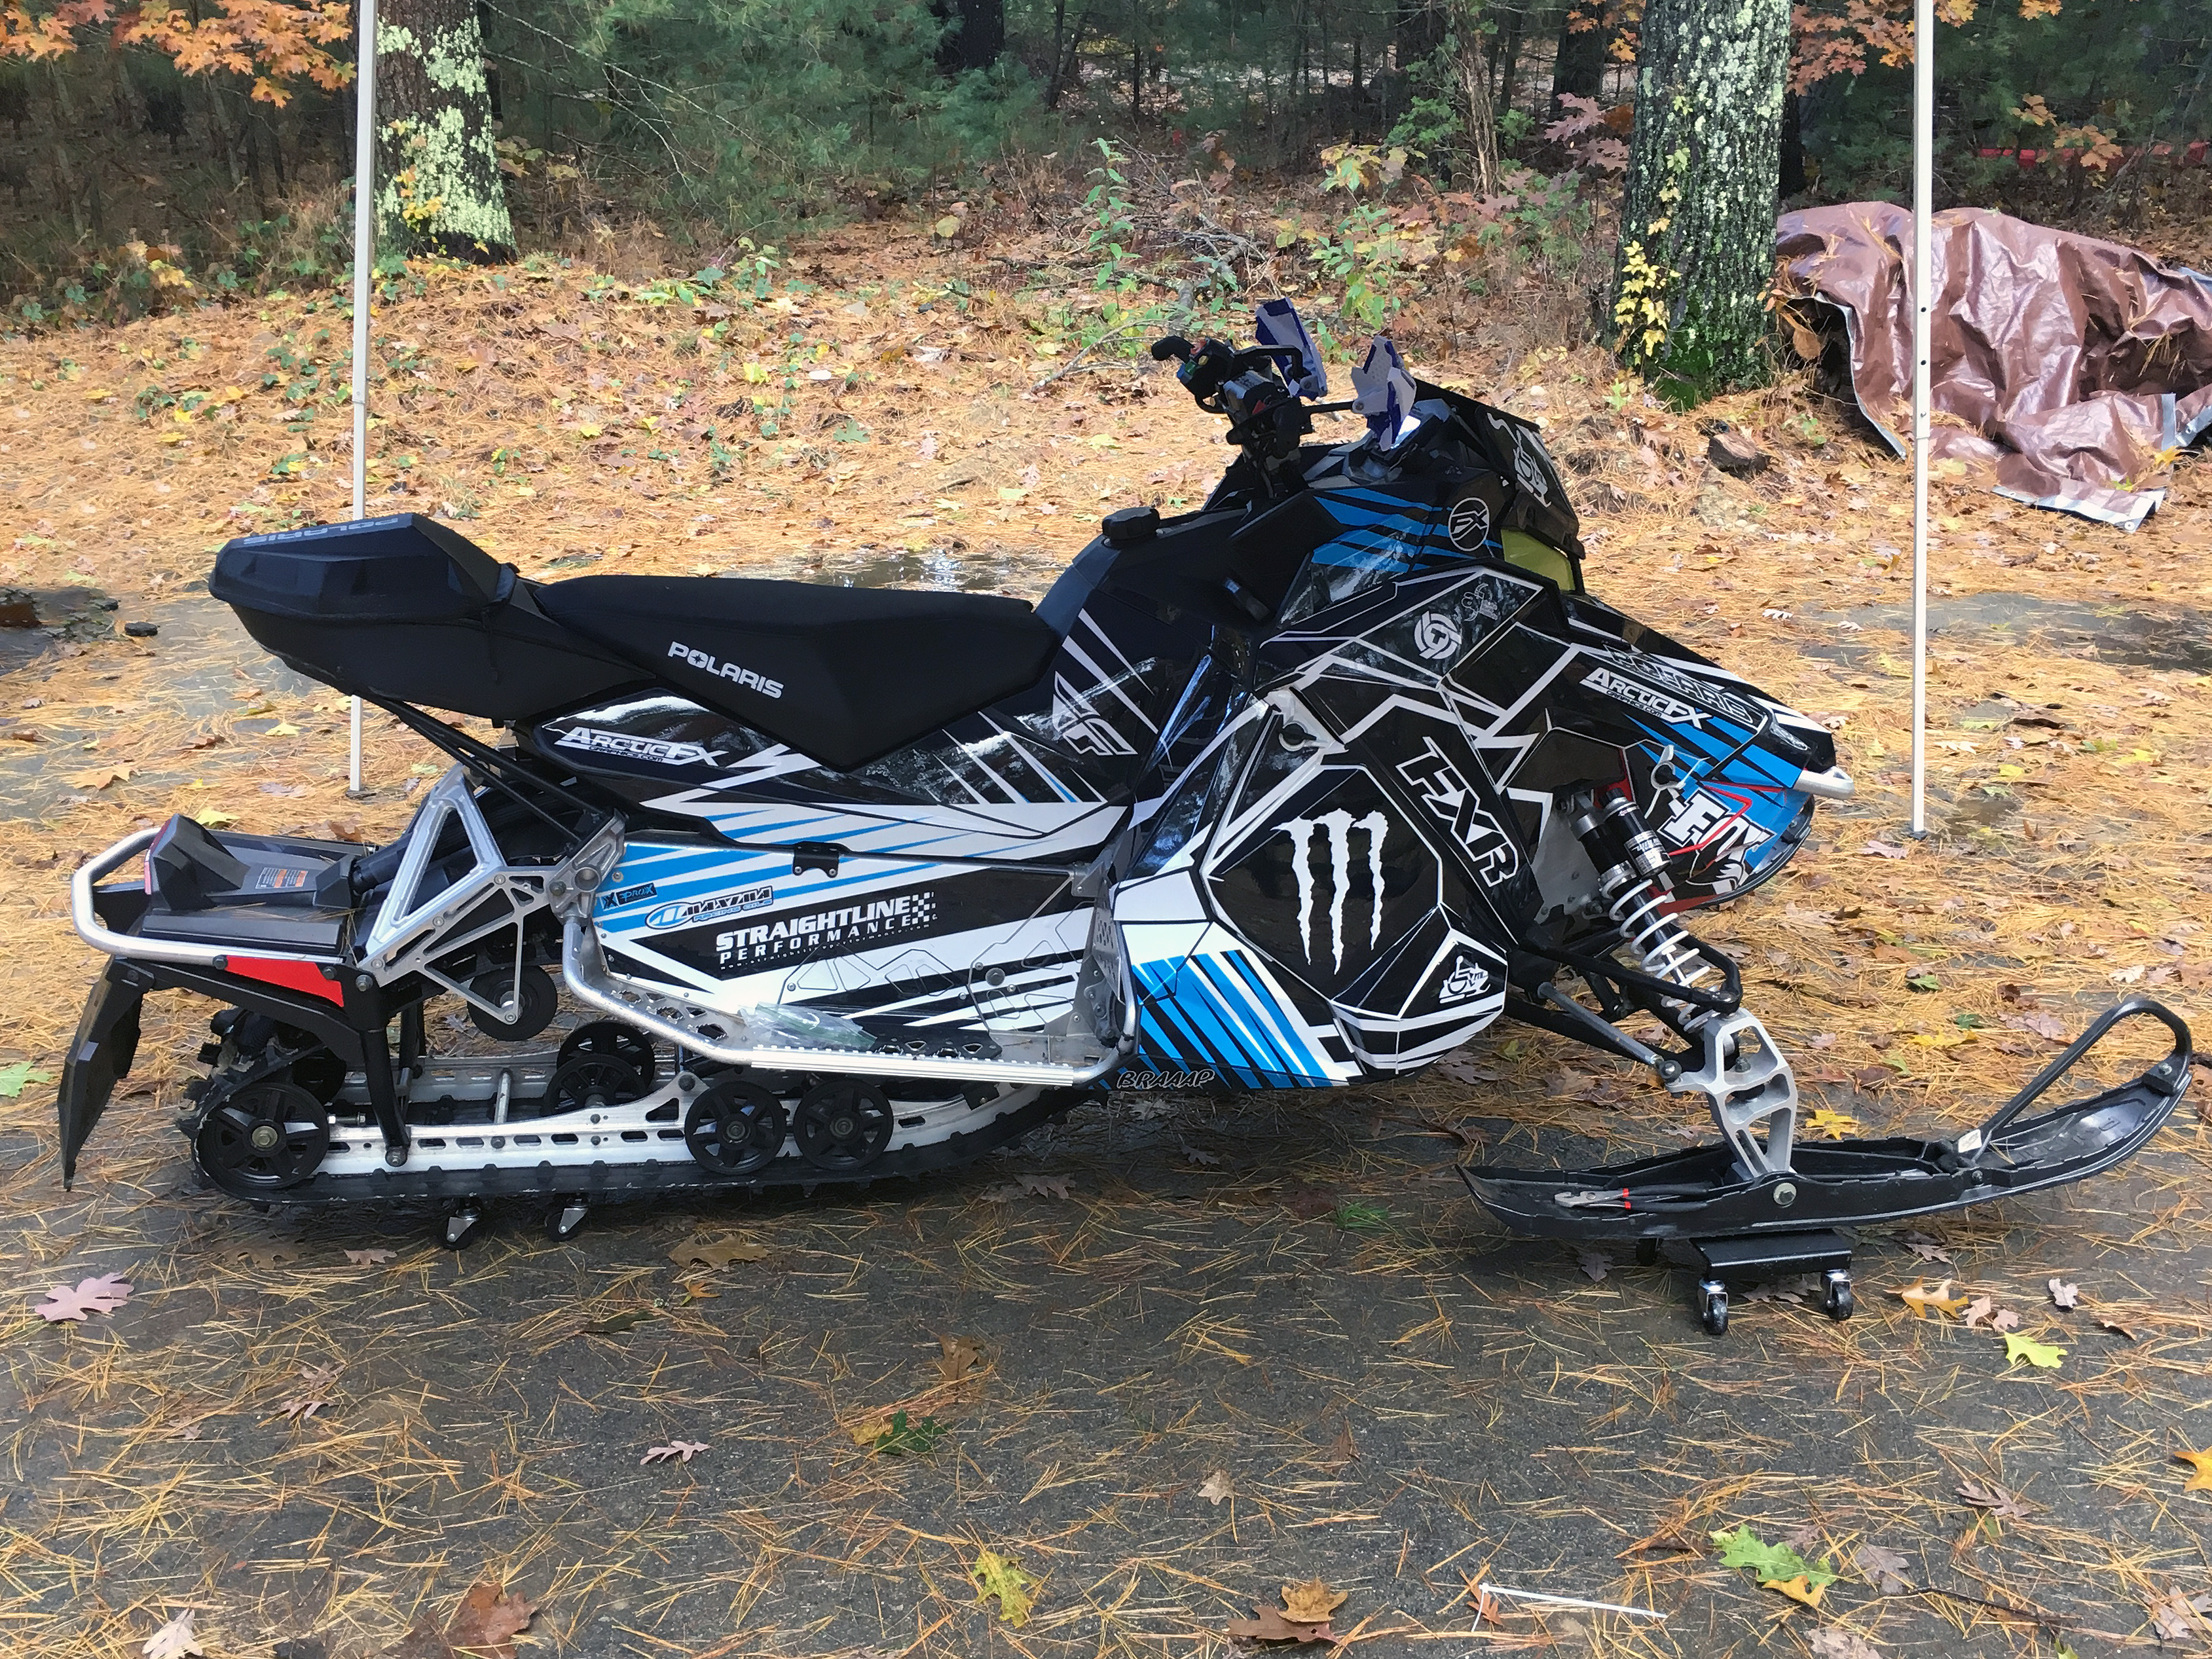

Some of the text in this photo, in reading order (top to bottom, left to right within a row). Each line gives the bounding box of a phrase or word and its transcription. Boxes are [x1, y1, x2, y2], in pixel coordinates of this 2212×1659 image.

[667, 641, 784, 699] POLARIS
[716, 895, 911, 952] STRAIGHTLINE
[720, 914, 912, 964] PERFORMANCE
[1116, 1068, 1216, 1090] BRAAAP
